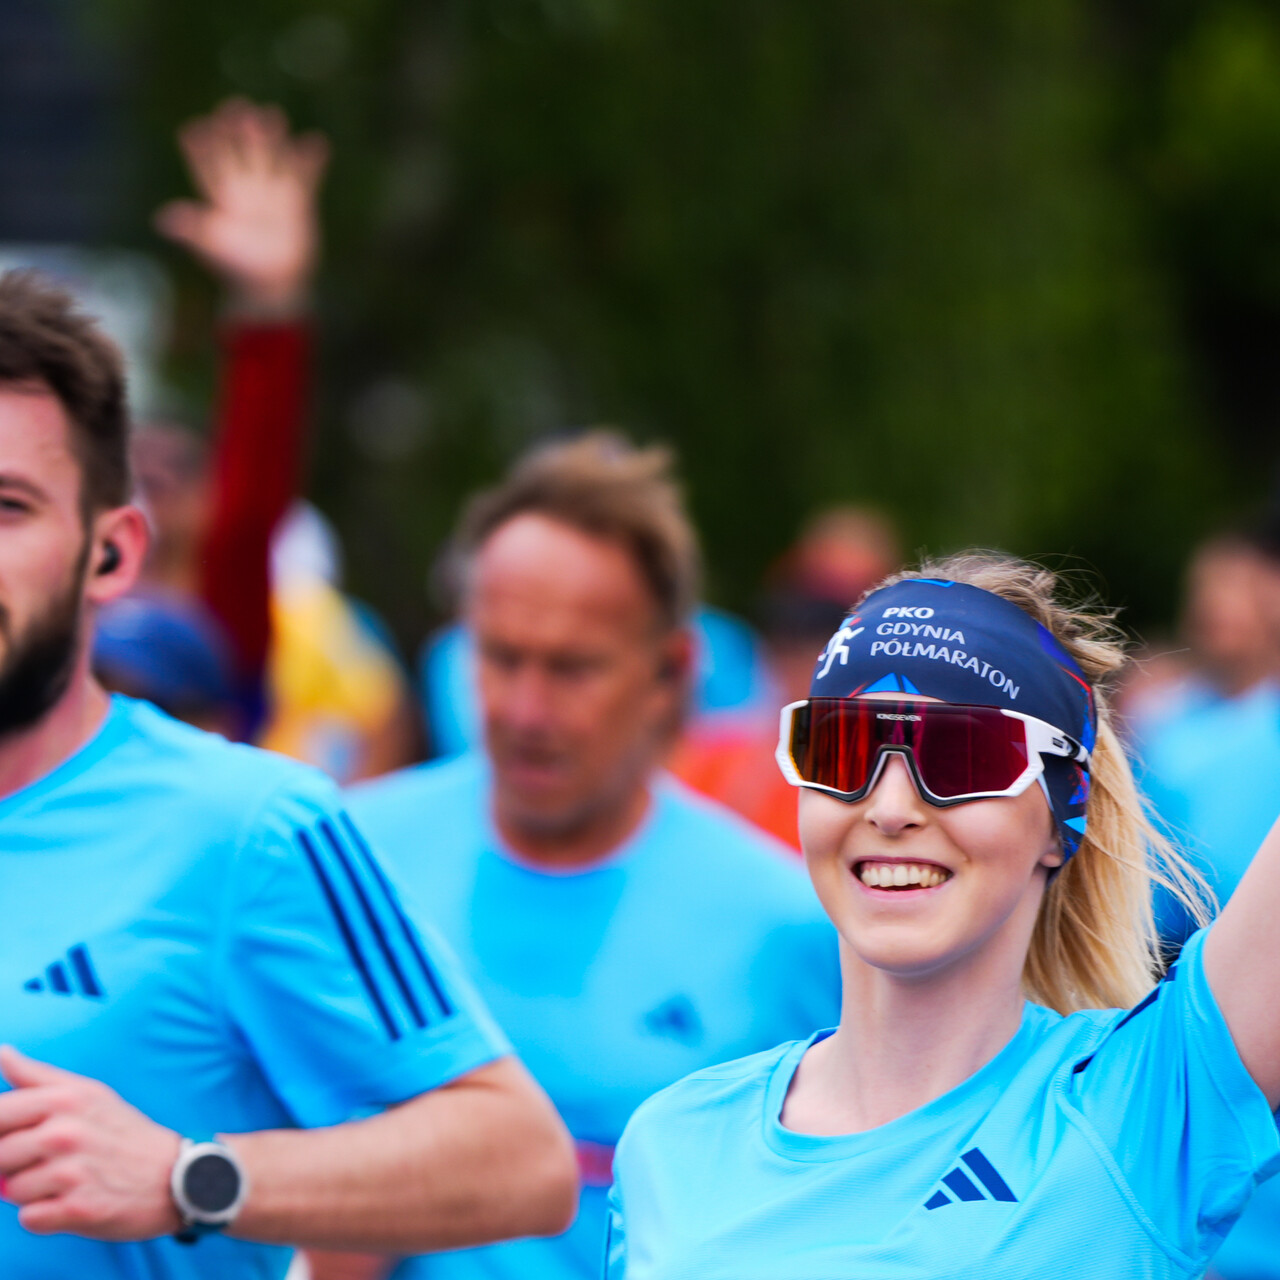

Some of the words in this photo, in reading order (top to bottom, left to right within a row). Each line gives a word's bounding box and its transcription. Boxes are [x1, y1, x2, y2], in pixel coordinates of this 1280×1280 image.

[881, 606, 934, 618] PKO
[876, 622, 966, 645] GDYNIA
[870, 638, 1020, 699] PÓŁMARATON
